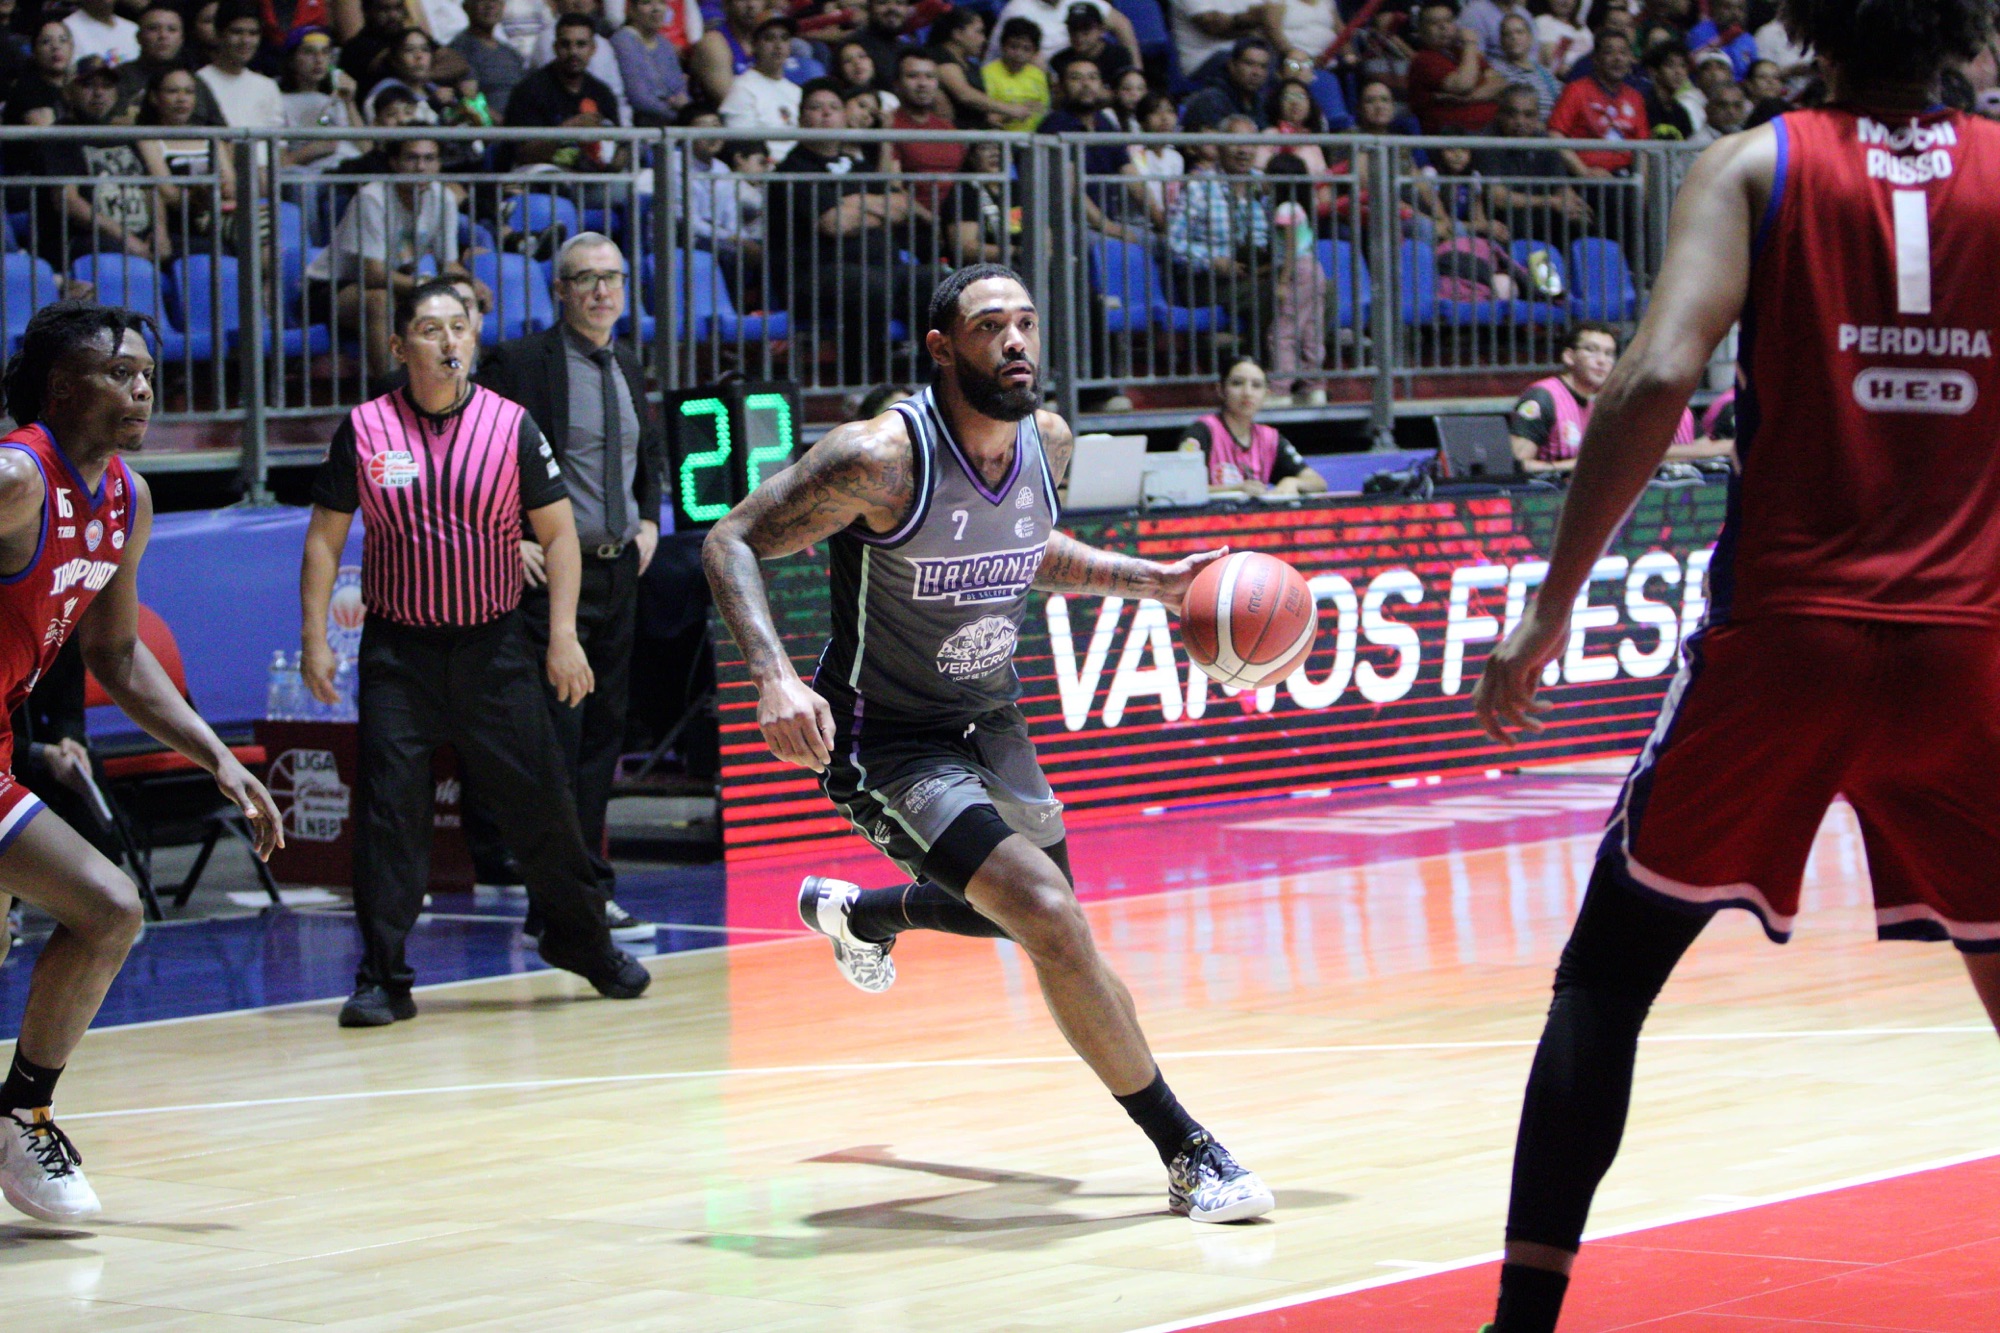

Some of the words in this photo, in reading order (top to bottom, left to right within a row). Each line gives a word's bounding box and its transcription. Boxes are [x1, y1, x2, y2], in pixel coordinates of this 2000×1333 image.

[1857, 117, 1957, 151] Mobil
[1866, 148, 1953, 185] RUSSO
[1893, 189, 1932, 314] 1
[1838, 323, 1992, 358] PERDURA
[680, 393, 794, 522] 22
[56, 487, 74, 518] 16
[952, 509, 969, 541] 7
[1046, 569, 1424, 731] VAOS
